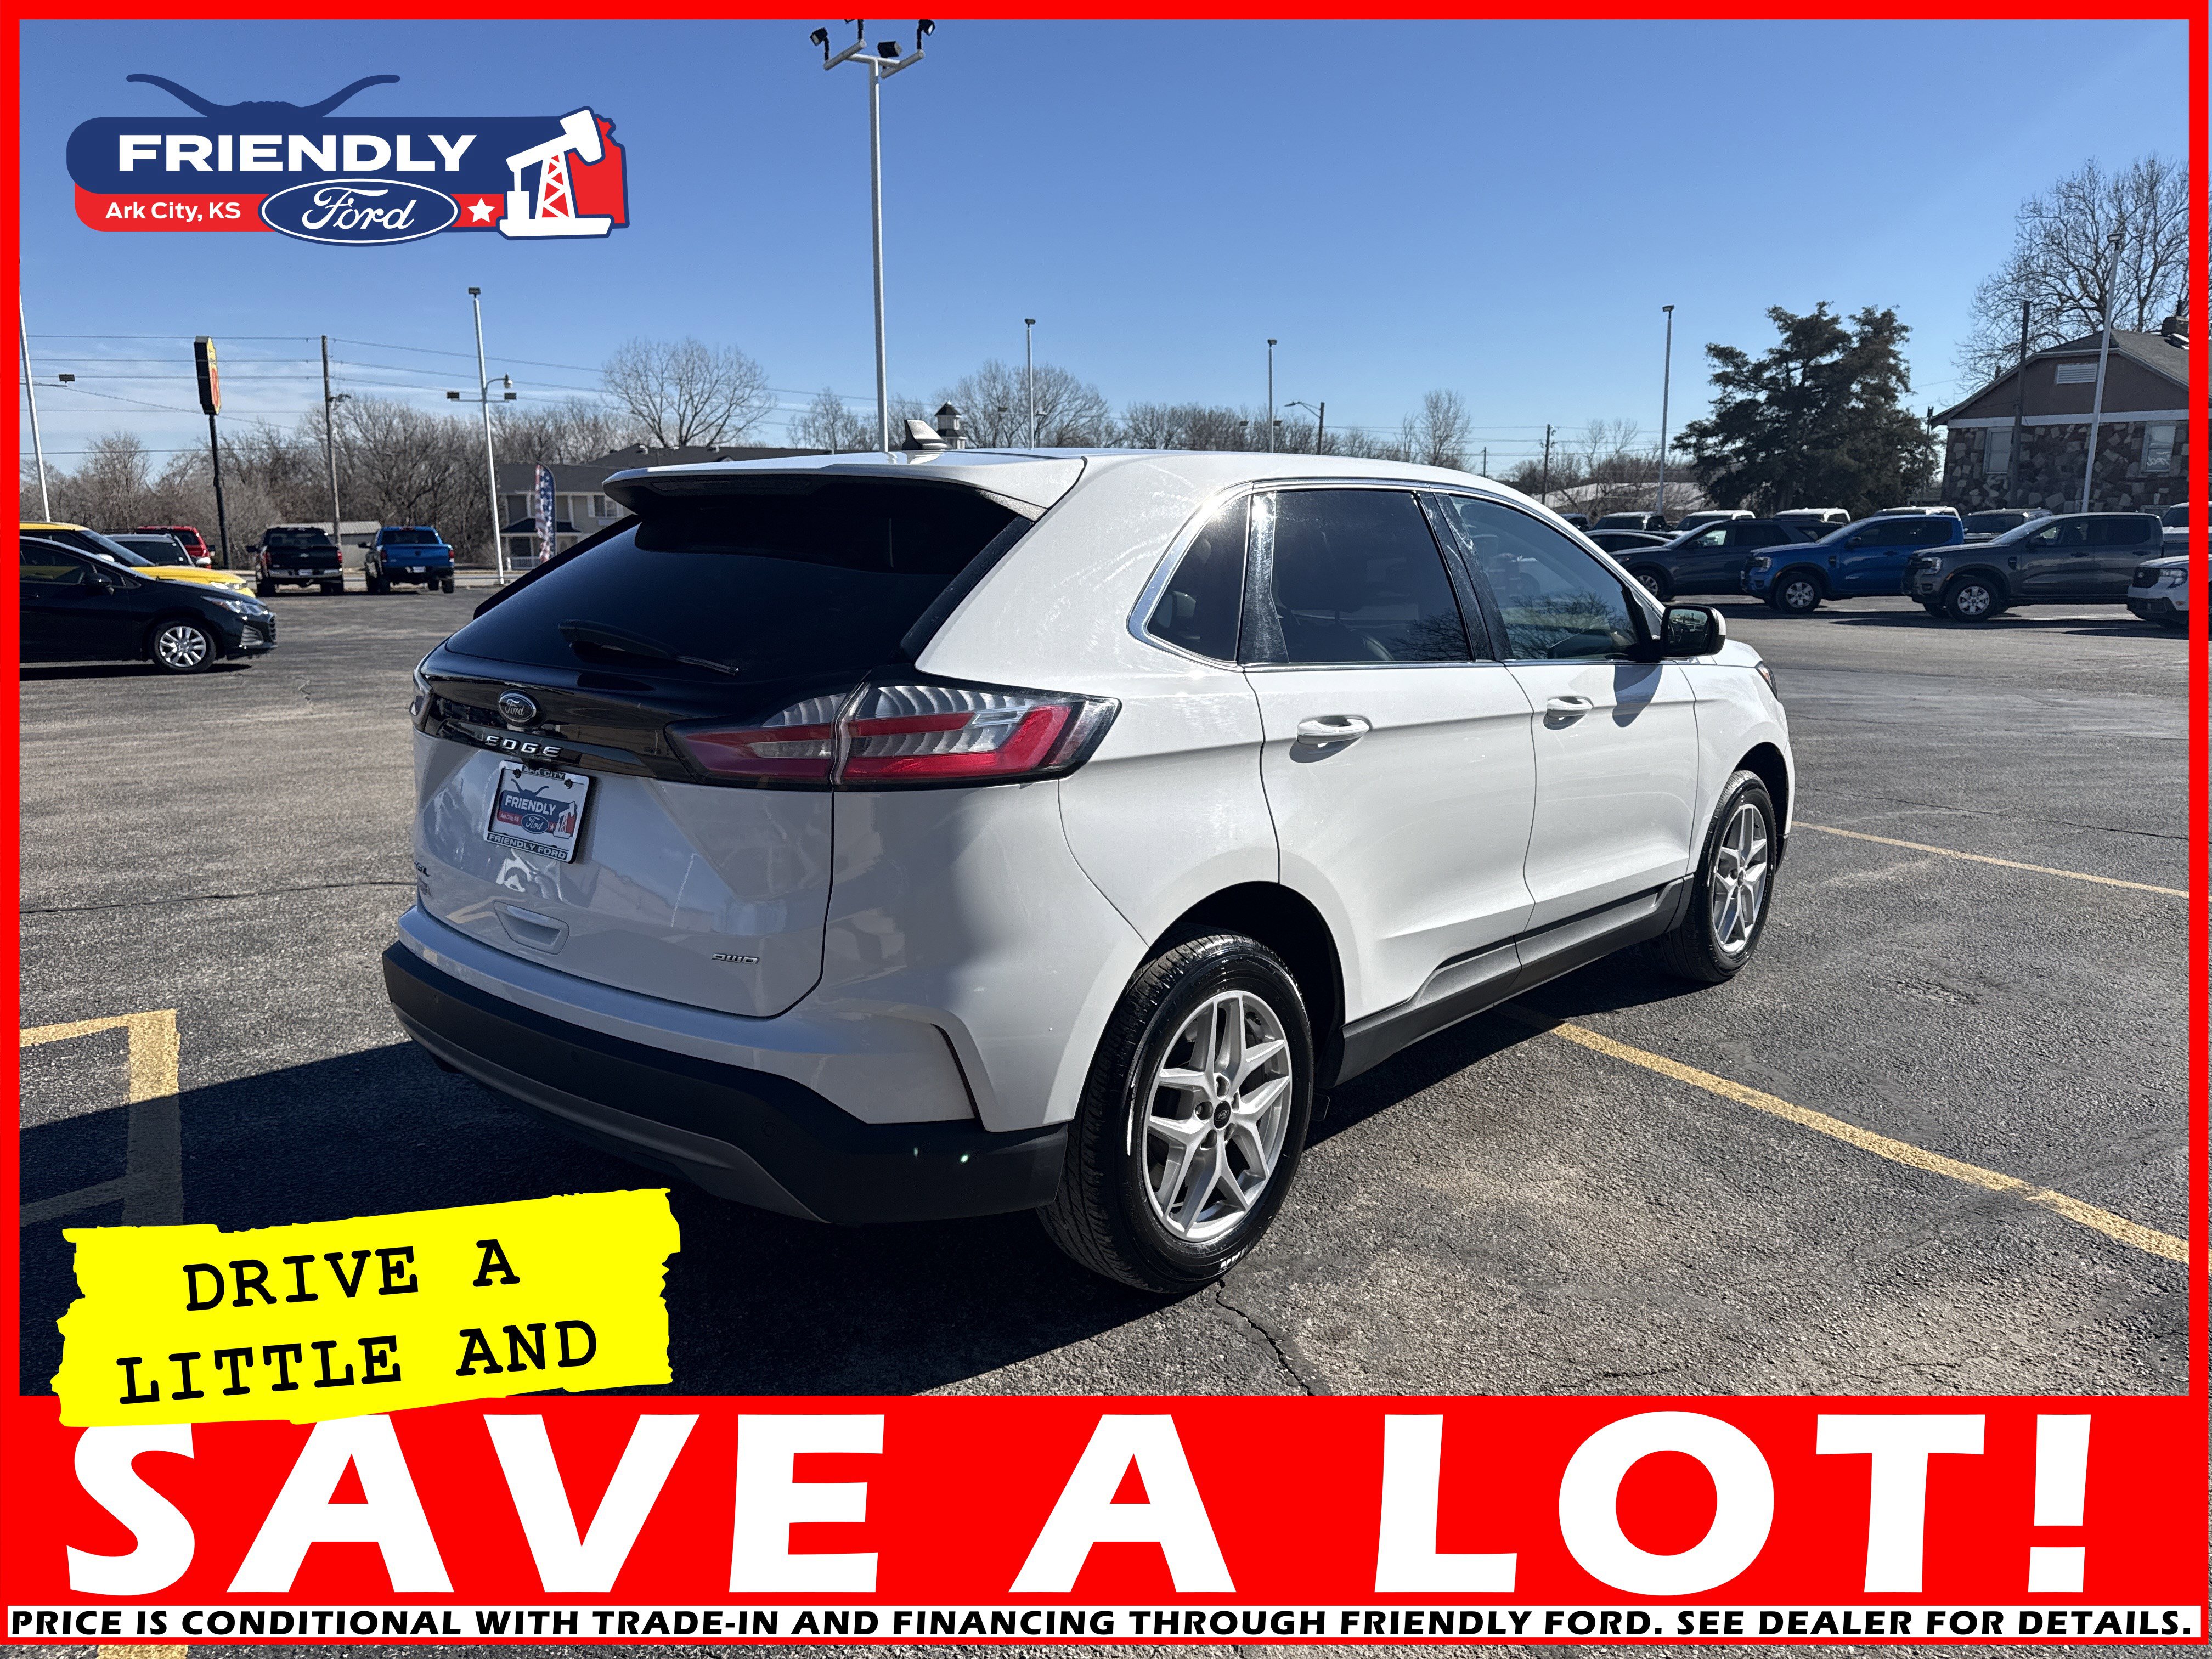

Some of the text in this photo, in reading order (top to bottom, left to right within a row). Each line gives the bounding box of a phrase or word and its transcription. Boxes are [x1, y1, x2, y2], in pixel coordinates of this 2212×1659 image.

[505, 698, 525, 716] Ford
[486, 736, 562, 757] EDGE
[543, 770, 565, 779] CITY
[504, 795, 557, 816] FRIENDLY
[526, 816, 544, 830] Ford
[489, 834, 566, 859] FRIENDLY FORD
[712, 952, 760, 964] AWD
